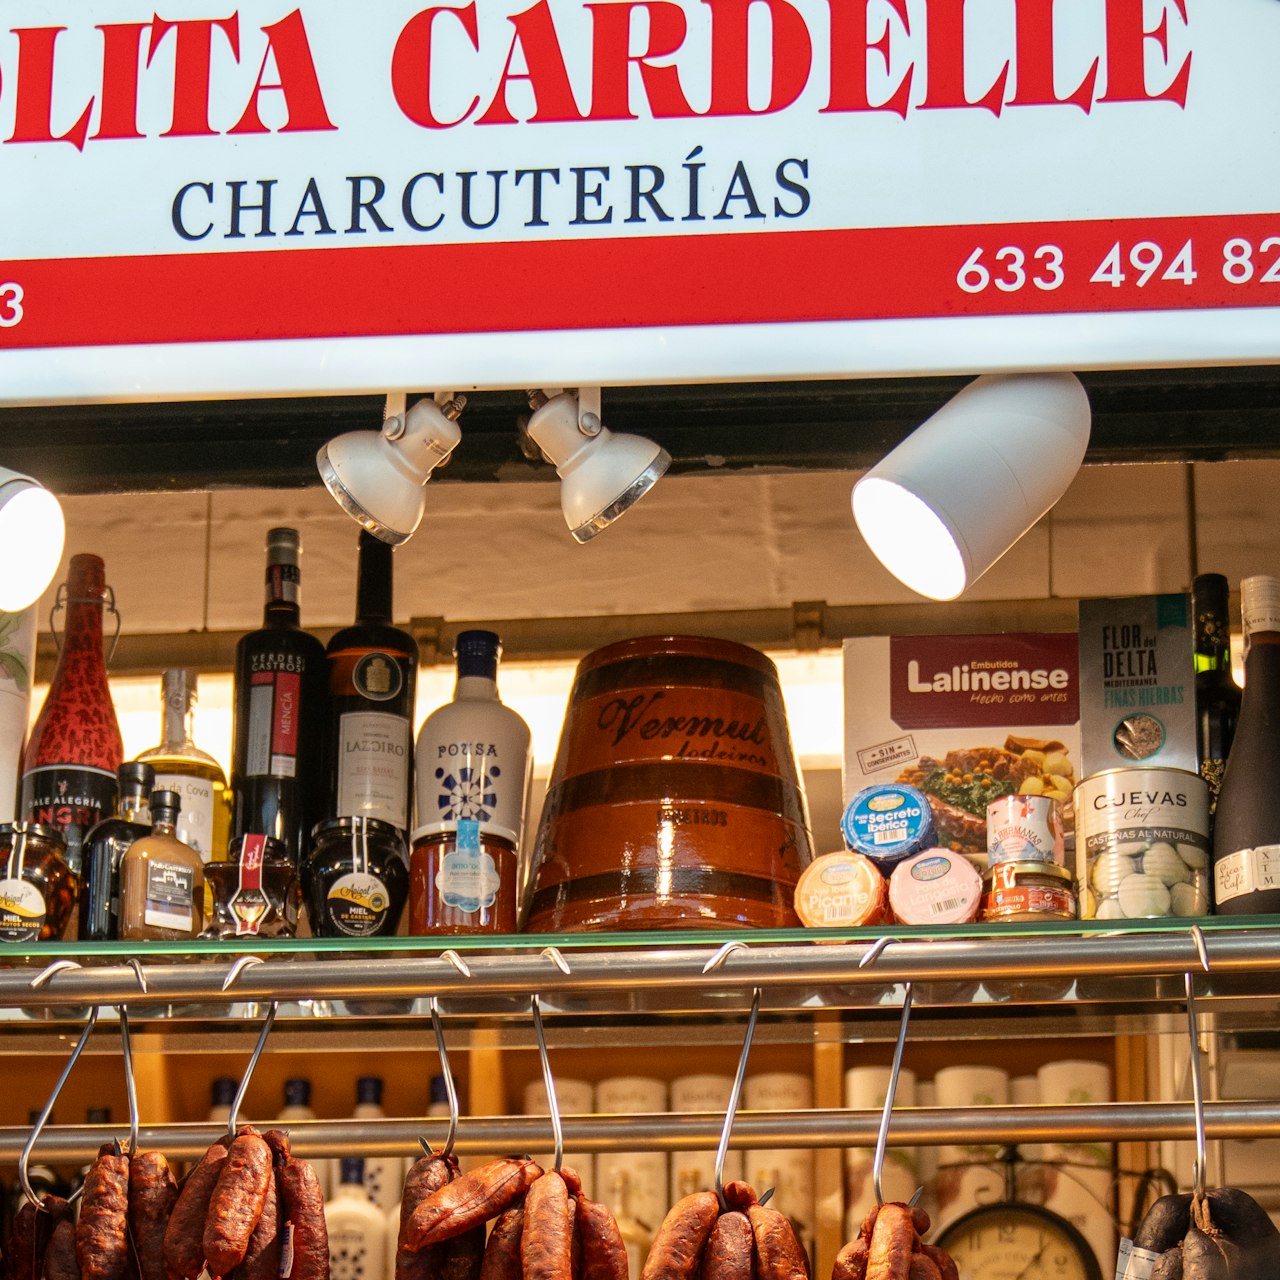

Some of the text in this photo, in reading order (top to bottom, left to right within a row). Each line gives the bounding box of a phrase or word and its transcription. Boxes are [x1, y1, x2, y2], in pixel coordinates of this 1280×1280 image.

[391, 0, 1193, 130] CARDELLE
[171, 146, 810, 241] CHARCUTERÍAS
[957, 245, 1064, 293] 633
[1089, 239, 1197, 287] 494
[1103, 625, 1157, 649] FLOR del
[251, 662, 302, 672] CASTROS
[970, 660, 1019, 669] Embutidos
[1104, 648, 1157, 678] DELTA
[907, 660, 1069, 693] Lalinense
[970, 692, 1067, 704] Hecho como antes
[437, 742, 499, 759] POUSA
[878, 745, 896, 757] SIN
[866, 750, 911, 768] CONSERVANTES
[1093, 791, 1187, 811] CUEVAS
[868, 807, 921, 823] Secreto
[1124, 806, 1160, 822] Chef
[867, 819, 909, 833] Ibérico
[1153, 830, 1195, 842] NATURAL
[809, 889, 869, 909] Picante
[3, 914, 22, 923] MIEL
[349, 907, 368, 915] MIEL
